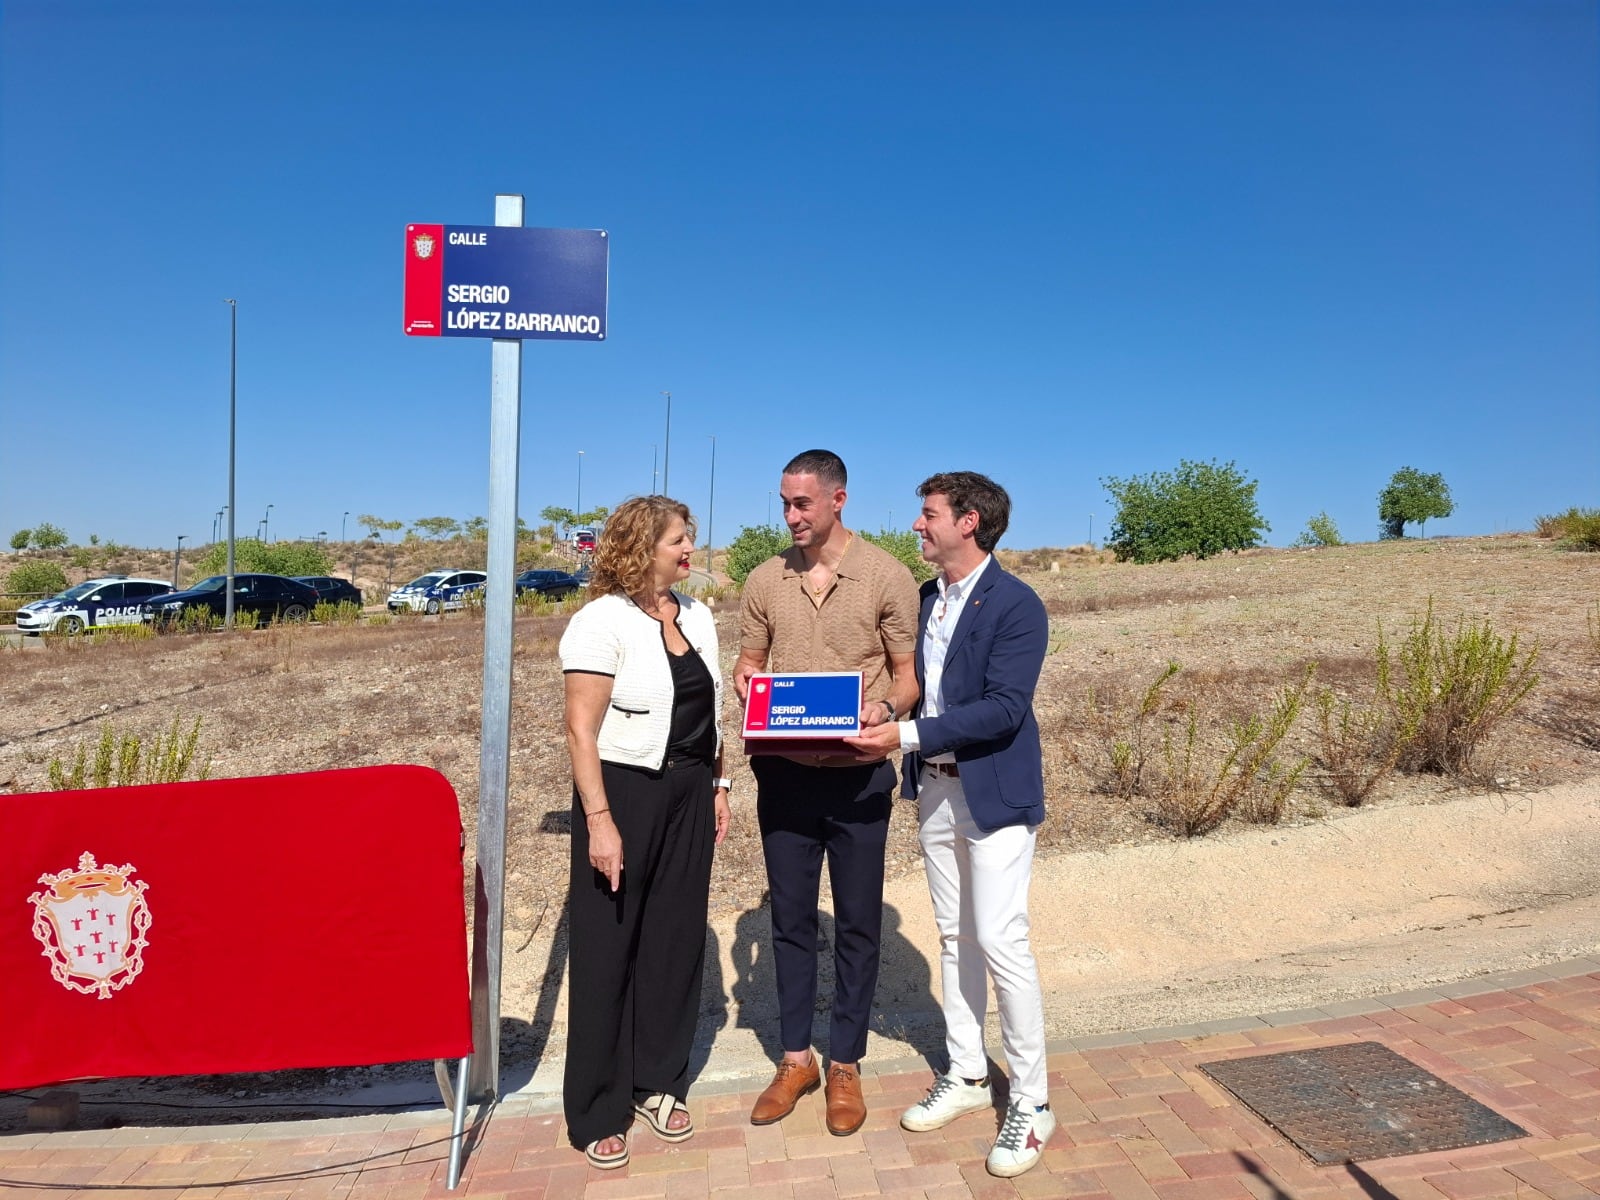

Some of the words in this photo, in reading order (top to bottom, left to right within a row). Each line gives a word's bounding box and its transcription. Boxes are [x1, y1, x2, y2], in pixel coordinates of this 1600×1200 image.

[449, 232, 487, 246] CALLE
[447, 285, 510, 304] SERGIO
[447, 307, 501, 330] LÓPEZ
[505, 312, 600, 334] BARRANCO
[95, 603, 142, 618] POLICÍ
[771, 705, 805, 714] SERGIO
[770, 716, 800, 725] LÓPEZ
[802, 716, 854, 725] BARRANCO
